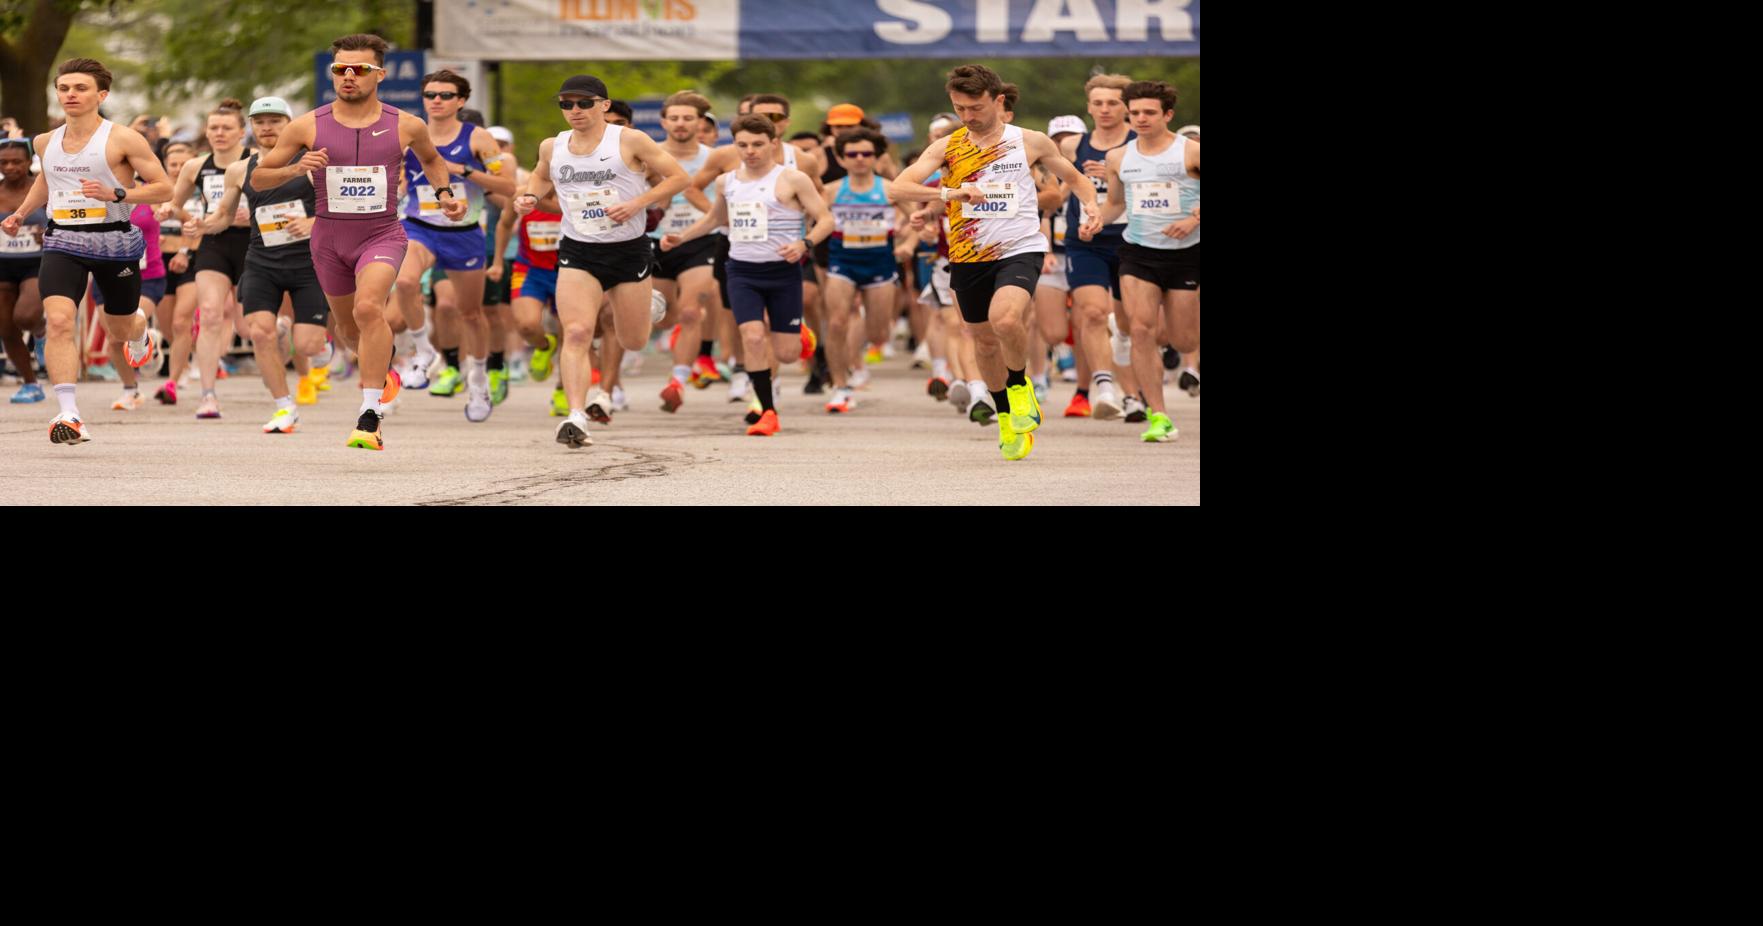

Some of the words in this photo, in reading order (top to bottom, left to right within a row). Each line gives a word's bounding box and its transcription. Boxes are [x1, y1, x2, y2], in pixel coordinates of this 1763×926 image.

[340, 186, 375, 196] 2022
[973, 201, 1007, 212] 2002
[1140, 199, 1169, 209] 2024
[69, 208, 86, 218] 36
[733, 219, 757, 227] 2012
